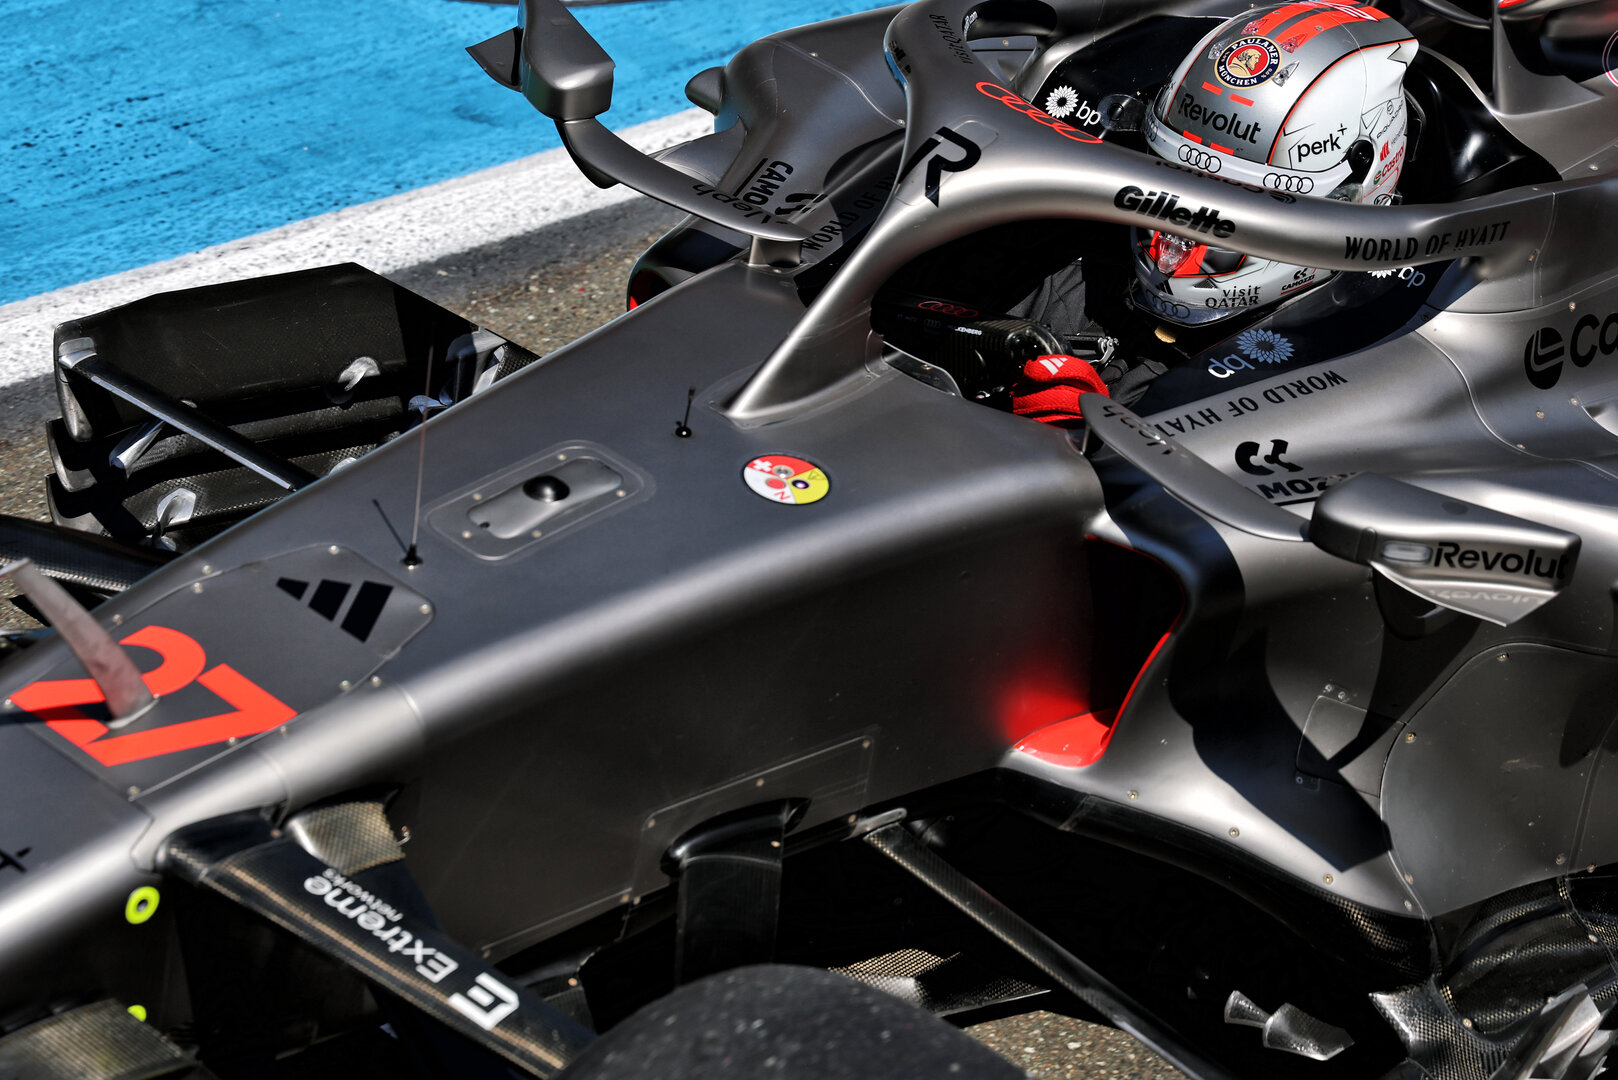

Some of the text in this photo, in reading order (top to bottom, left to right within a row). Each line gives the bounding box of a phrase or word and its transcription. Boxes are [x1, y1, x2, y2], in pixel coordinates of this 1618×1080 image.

[1231, 38, 1279, 65] PAULANER
[1075, 100, 1102, 126] bp
[1177, 93, 1262, 144] Revolut
[742, 160, 794, 207] CAMO
[801, 191, 883, 251] WORLD OF
[1113, 185, 1236, 239] Gillette
[1344, 220, 1512, 262] WORLD OF HYATT
[1222, 285, 1262, 298] visit
[1281, 274, 1316, 291] CAMOZZI
[1204, 295, 1260, 310] QATAR
[1207, 351, 1256, 379] bp
[1262, 369, 1349, 405] WORLD
[1152, 407, 1224, 438] HYAT
[1227, 396, 1260, 418] OF
[1433, 541, 1571, 580] Revolut
[9, 624, 299, 767] 27
[321, 867, 404, 922] networks
[303, 875, 459, 984] Extreme
